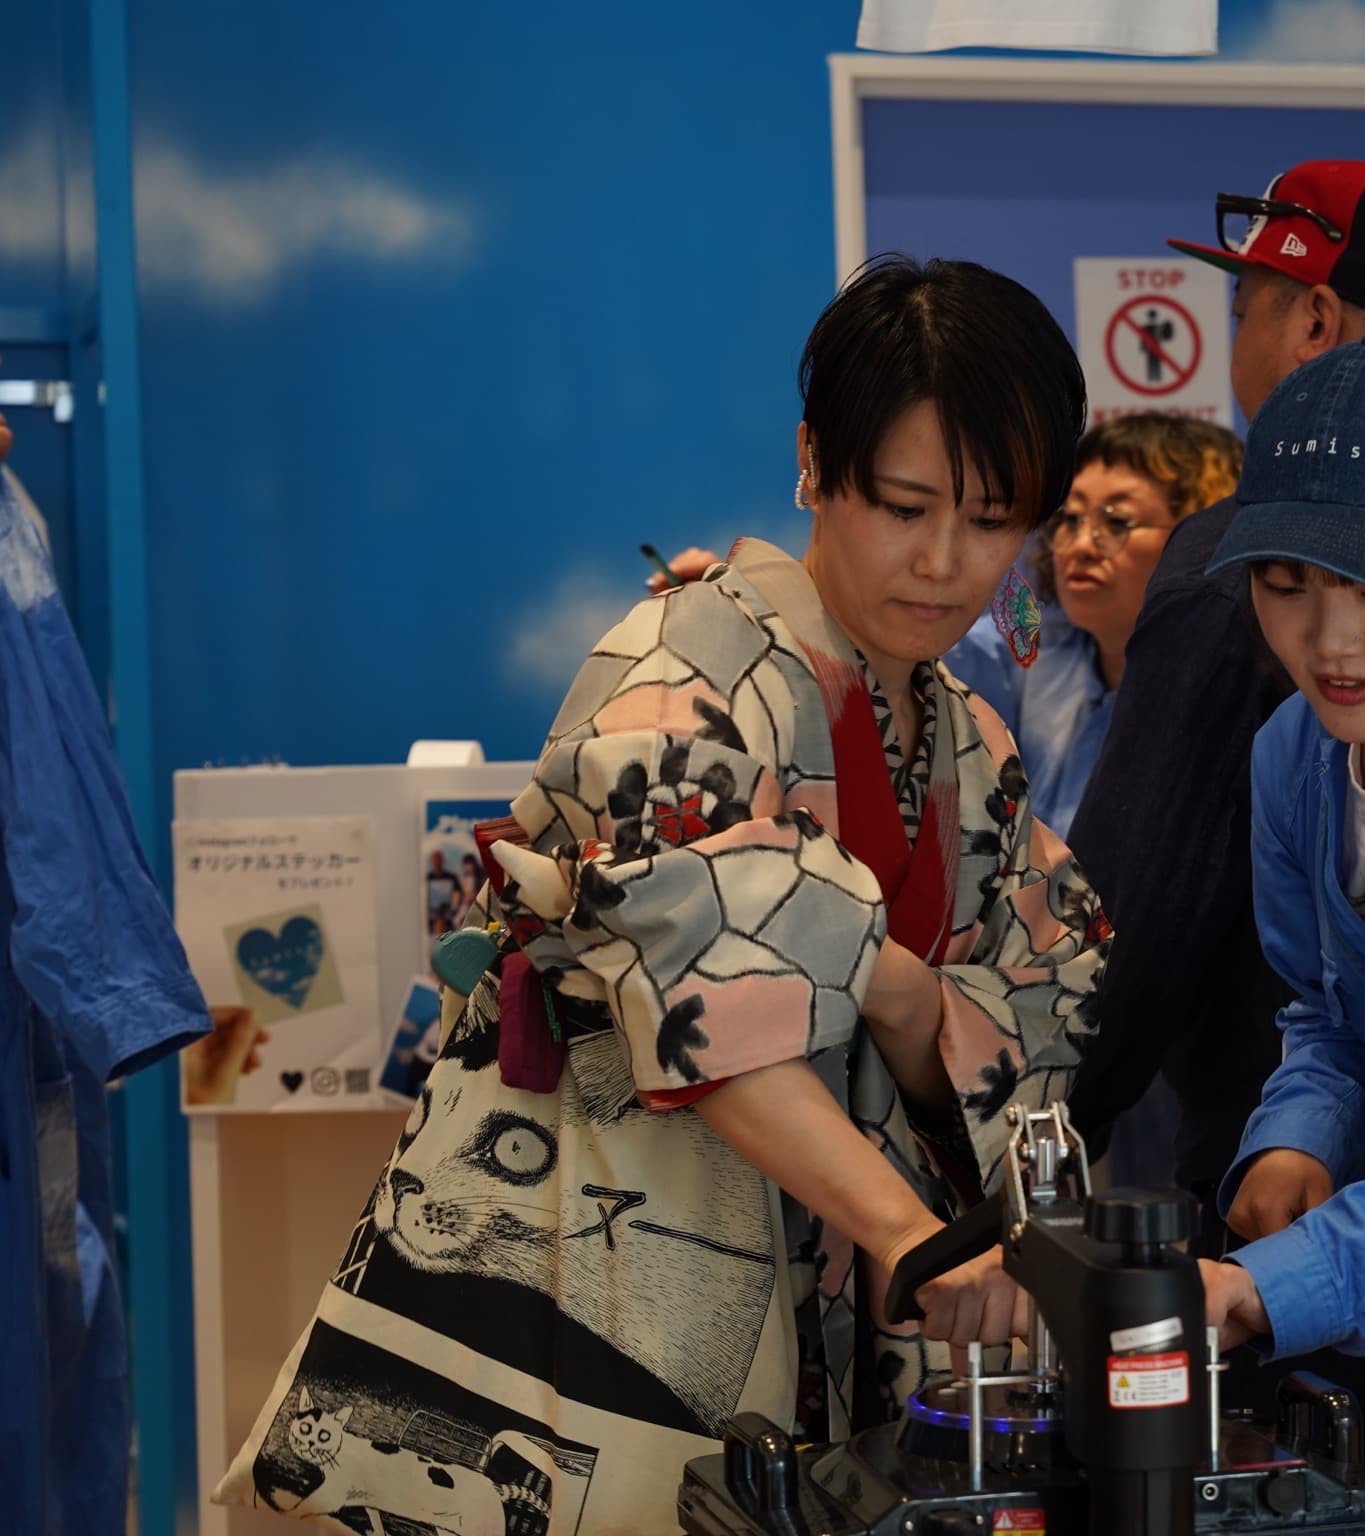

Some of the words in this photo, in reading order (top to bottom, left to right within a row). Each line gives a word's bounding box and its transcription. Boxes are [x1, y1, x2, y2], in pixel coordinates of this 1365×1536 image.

[1118, 269, 1185, 290] STOP
[188, 854, 361, 875] オリジナルステッカー
